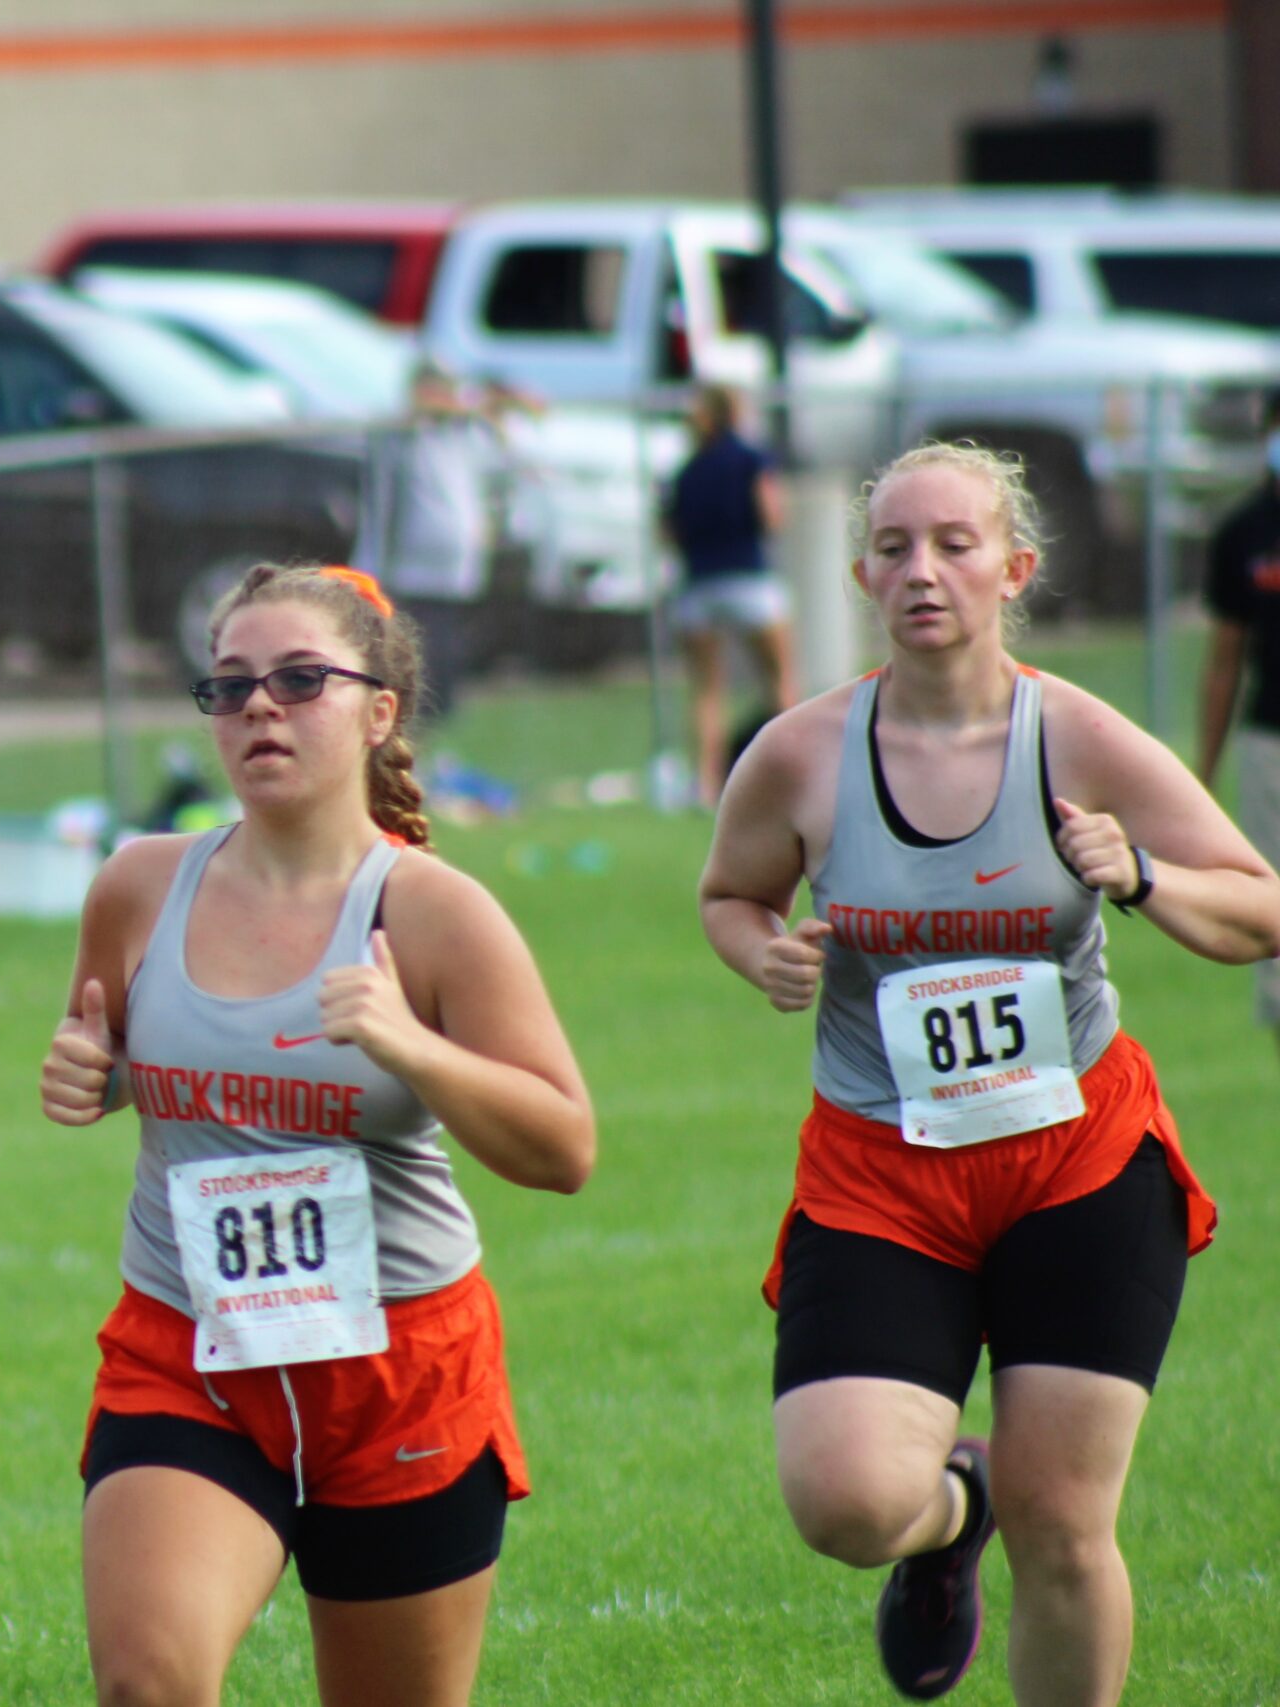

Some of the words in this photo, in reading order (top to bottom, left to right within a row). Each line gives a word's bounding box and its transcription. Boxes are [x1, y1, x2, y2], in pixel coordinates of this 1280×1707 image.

[829, 903, 1055, 955] STOCKBRIDGE
[907, 967, 1025, 1001] STOCKBRIDGE
[923, 993, 1026, 1074] 815
[930, 1066, 1038, 1101] INVITATIONAL
[199, 1166, 331, 1197] STOCKBRIDGE
[215, 1198, 326, 1281] 810
[217, 1284, 339, 1315] INVITATIONAL
